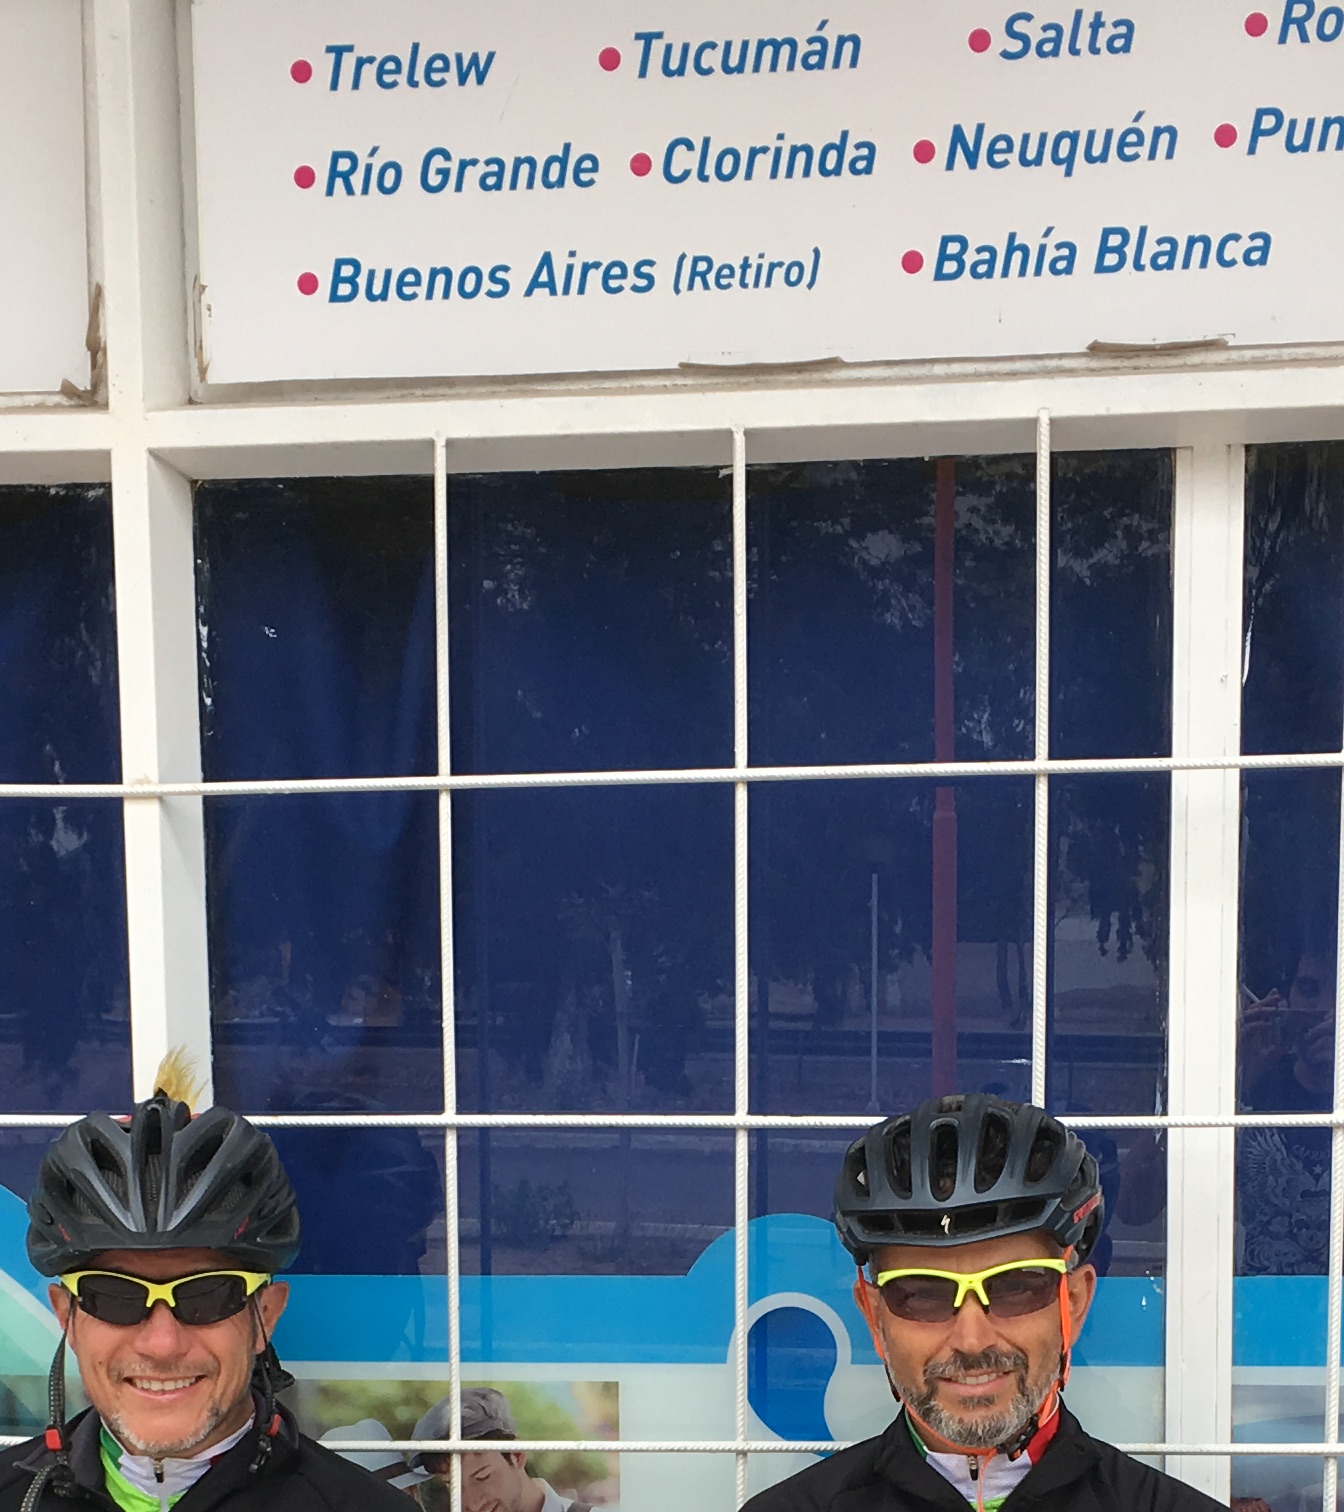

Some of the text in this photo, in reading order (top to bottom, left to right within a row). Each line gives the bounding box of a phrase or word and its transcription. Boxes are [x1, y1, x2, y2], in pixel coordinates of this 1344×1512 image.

[636, 21, 860, 77] Tucumán
[1001, 10, 1134, 60] Salta
[326, 44, 494, 90] Trelew
[326, 144, 598, 196] Río Grande
[663, 131, 875, 183] Clorinda
[946, 113, 1177, 176] Neuquén
[329, 249, 820, 303] Buenos Aires (Retiro)
[934, 226, 1271, 281] Bahía Blanca
